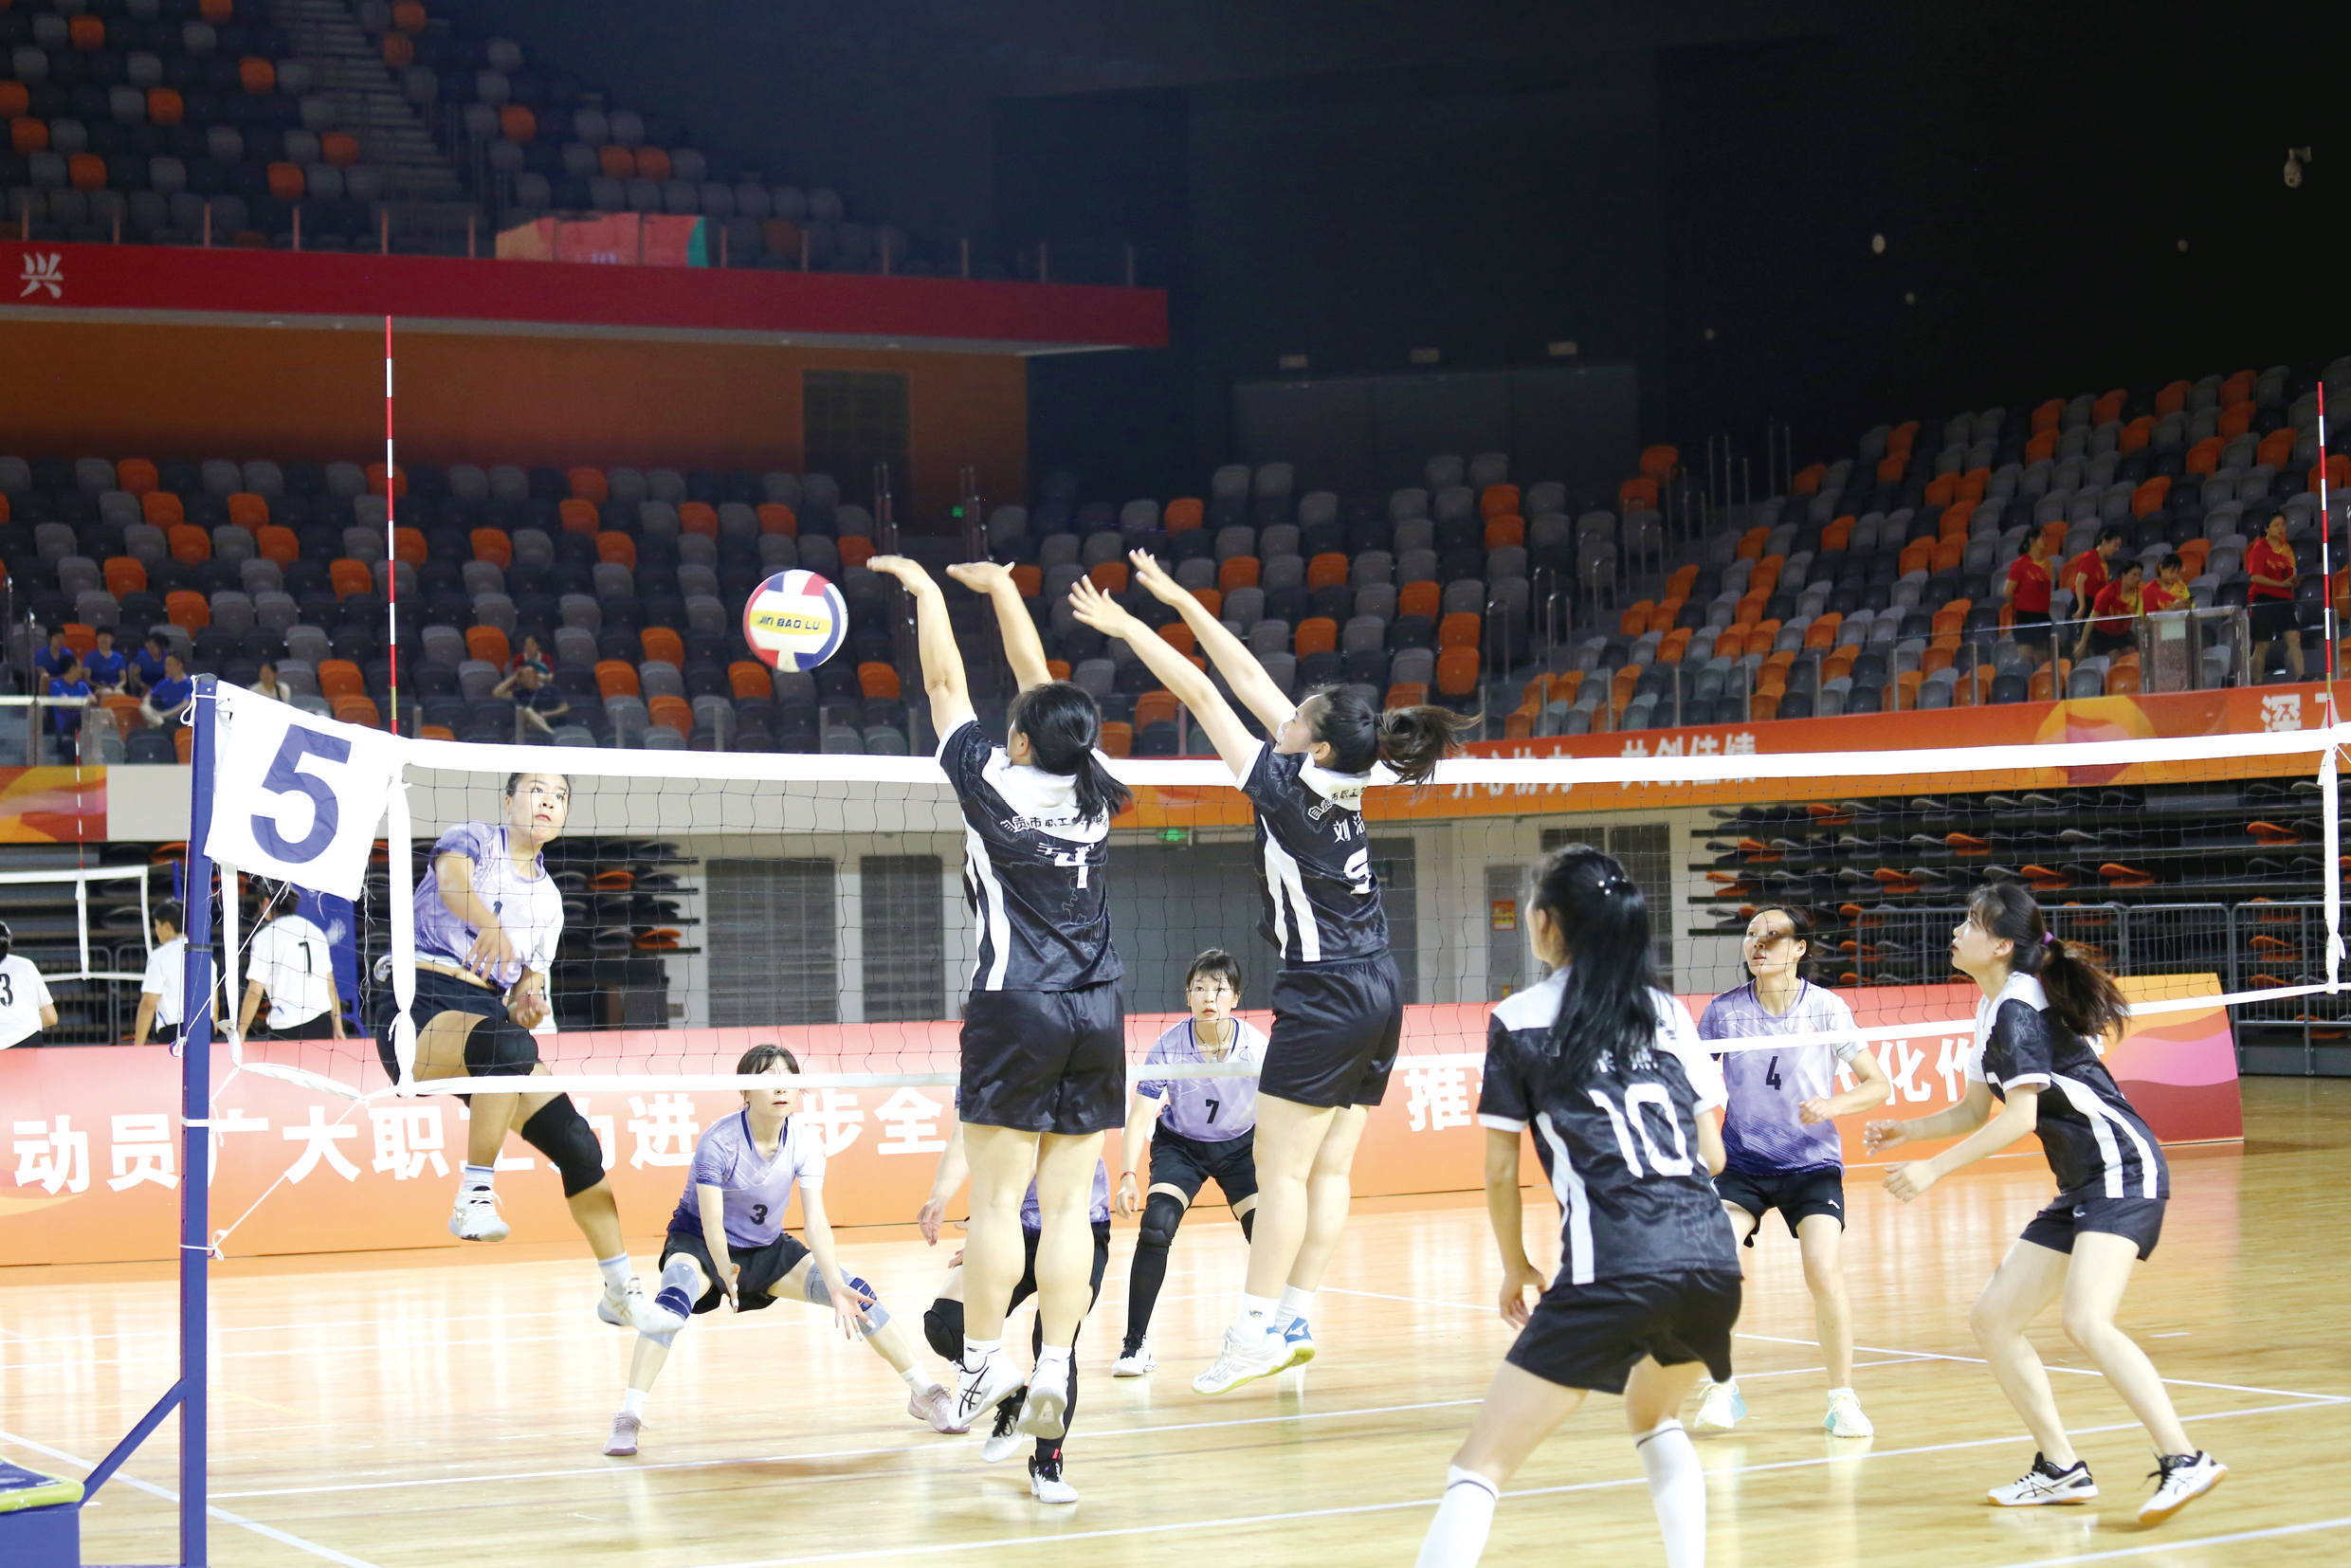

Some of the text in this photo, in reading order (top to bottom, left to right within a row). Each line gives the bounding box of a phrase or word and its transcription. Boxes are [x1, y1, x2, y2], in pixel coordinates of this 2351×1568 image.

[20, 251, 64, 299] 兴
[776, 617, 802, 629] BAO
[805, 620, 821, 630] LU
[250, 723, 352, 864] 5
[1765, 1055, 1781, 1090] 4
[1205, 1099, 1220, 1124] 7
[1404, 1067, 1471, 1132] 推
[1588, 1083, 1694, 1178] 10
[750, 1204, 768, 1225] 3
